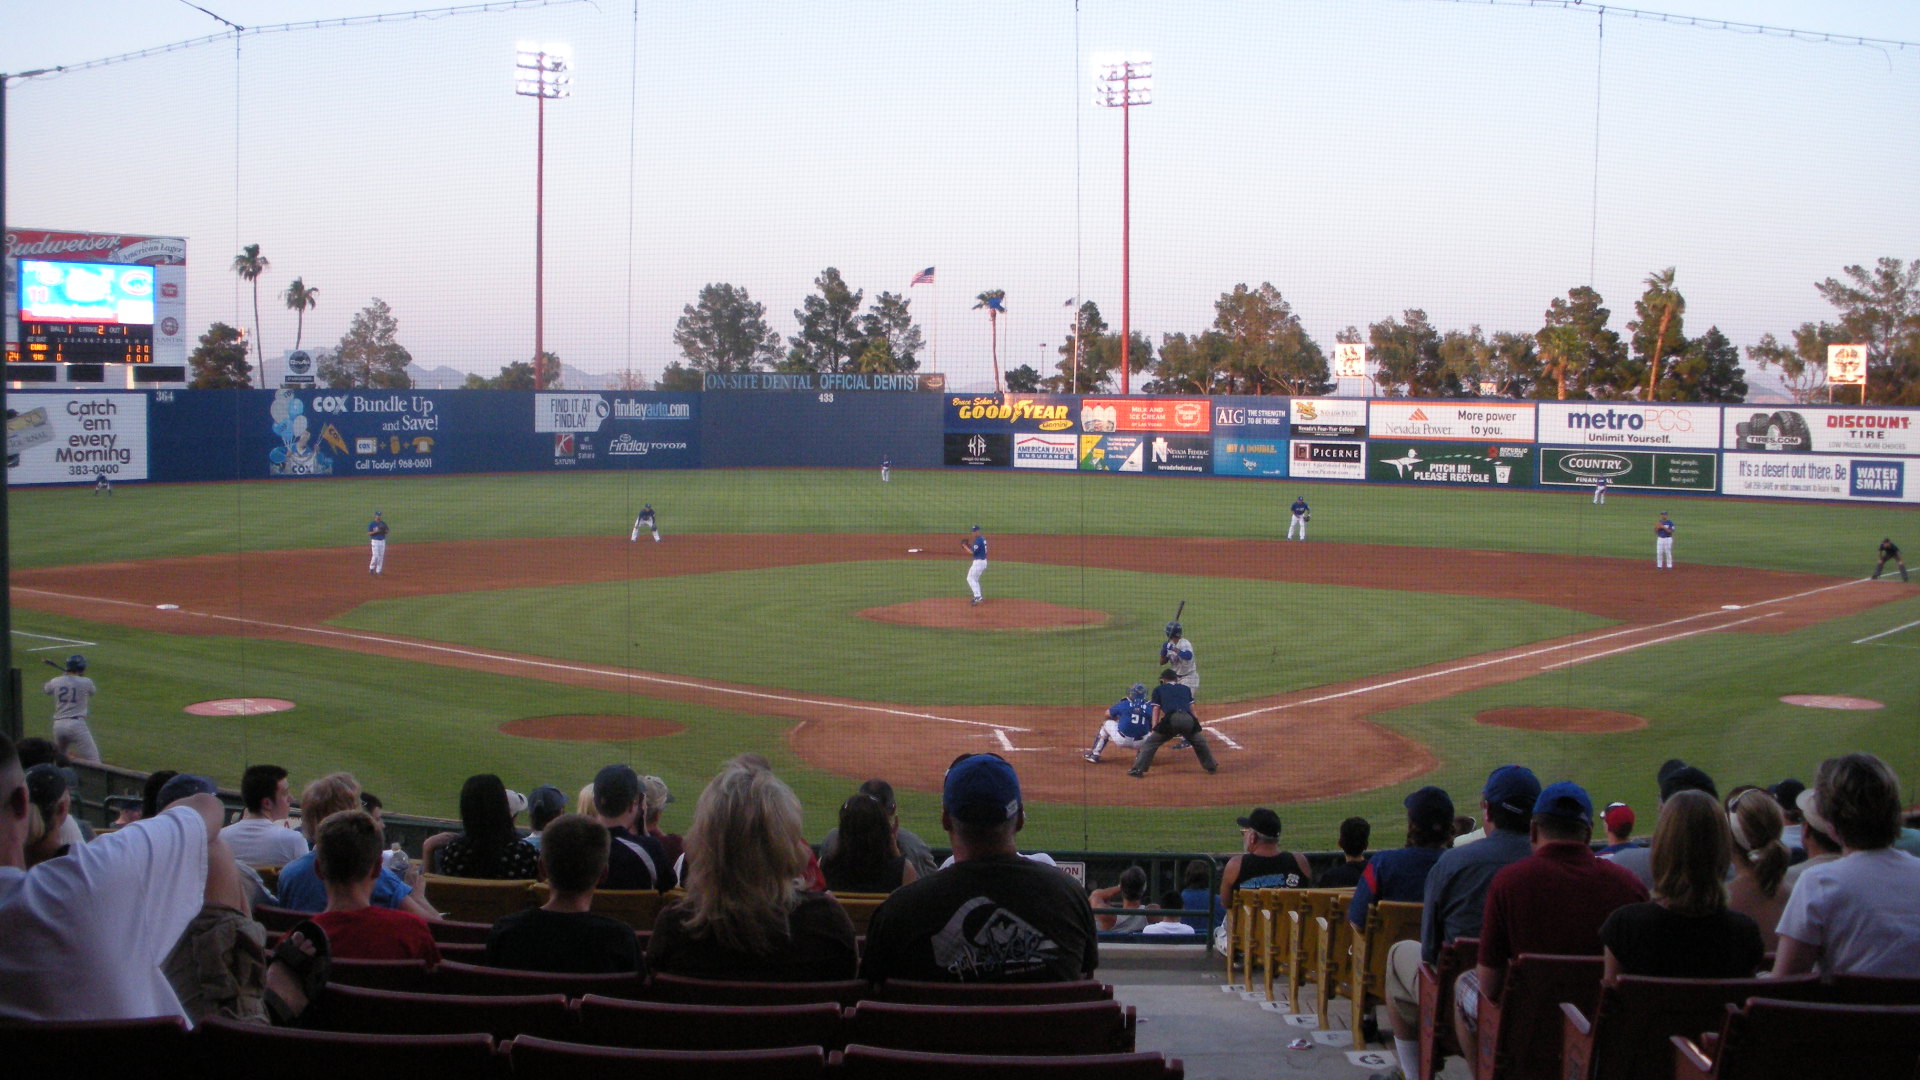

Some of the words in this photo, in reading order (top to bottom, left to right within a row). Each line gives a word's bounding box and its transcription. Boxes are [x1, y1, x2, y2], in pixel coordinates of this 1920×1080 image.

[6, 235, 121, 257] Budweiser
[121, 245, 159, 261] American
[160, 243, 184, 254] Lager
[98, 325, 105, 335] 2
[706, 374, 758, 390] ON-SITE
[762, 374, 814, 390] DENTAL
[819, 373, 871, 391] OFFICIAL
[873, 374, 920, 391] DENTIST
[156, 391, 175, 402] 364
[66, 399, 117, 416] Catch
[353, 395, 408, 413] Bundle
[412, 396, 434, 417] Up
[551, 398, 571, 413] FIND
[571, 398, 580, 413] IT
[581, 398, 592, 413] AT
[614, 398, 690, 420] findlayauto.com
[554, 413, 588, 428] FINDLAY
[1218, 409, 1244, 424] AIG
[1248, 409, 1258, 417] THE
[1258, 410, 1286, 418] STRENGTH
[1458, 410, 1483, 421] More
[1485, 411, 1517, 424] power
[79, 415, 112, 431] 'em
[382, 421, 400, 431] and
[402, 414, 439, 432] Save!
[1385, 422, 1421, 435] Nevada
[1826, 414, 1910, 429] DISCOUNT
[1471, 425, 1481, 434] to
[1482, 426, 1503, 437] you.
[1849, 430, 1885, 439] TIRE
[69, 433, 117, 450] every
[1588, 433, 1625, 442] Unlimit
[1627, 433, 1672, 444] Yourself.
[1749, 436, 1799, 444] TIRES.COM
[609, 439, 650, 455] Findlay
[1017, 446, 1050, 454] AMERICAN
[1051, 446, 1074, 455] FAMILY
[1313, 448, 1359, 458] PICERNE
[55, 444, 131, 465] Morning
[68, 464, 119, 476] 383-0400
[355, 459, 371, 470] Call
[372, 459, 397, 472] Today!
[398, 458, 433, 469] 968-0601
[1429, 463, 1455, 473] PITCH
[1457, 464, 1471, 473] IN!
[1739, 460, 1752, 477] It's
[1754, 465, 1759, 477] a
[1761, 461, 1789, 479] desert
[1792, 463, 1806, 479] out
[1807, 463, 1833, 480] there.
[1834, 463, 1847, 480] Be
[1414, 472, 1447, 481] PLEASE
[1449, 472, 1490, 483] RECYCLE
[1856, 467, 1898, 481] WATER
[1855, 479, 1898, 491] SMART
[58, 686, 77, 703] 21
